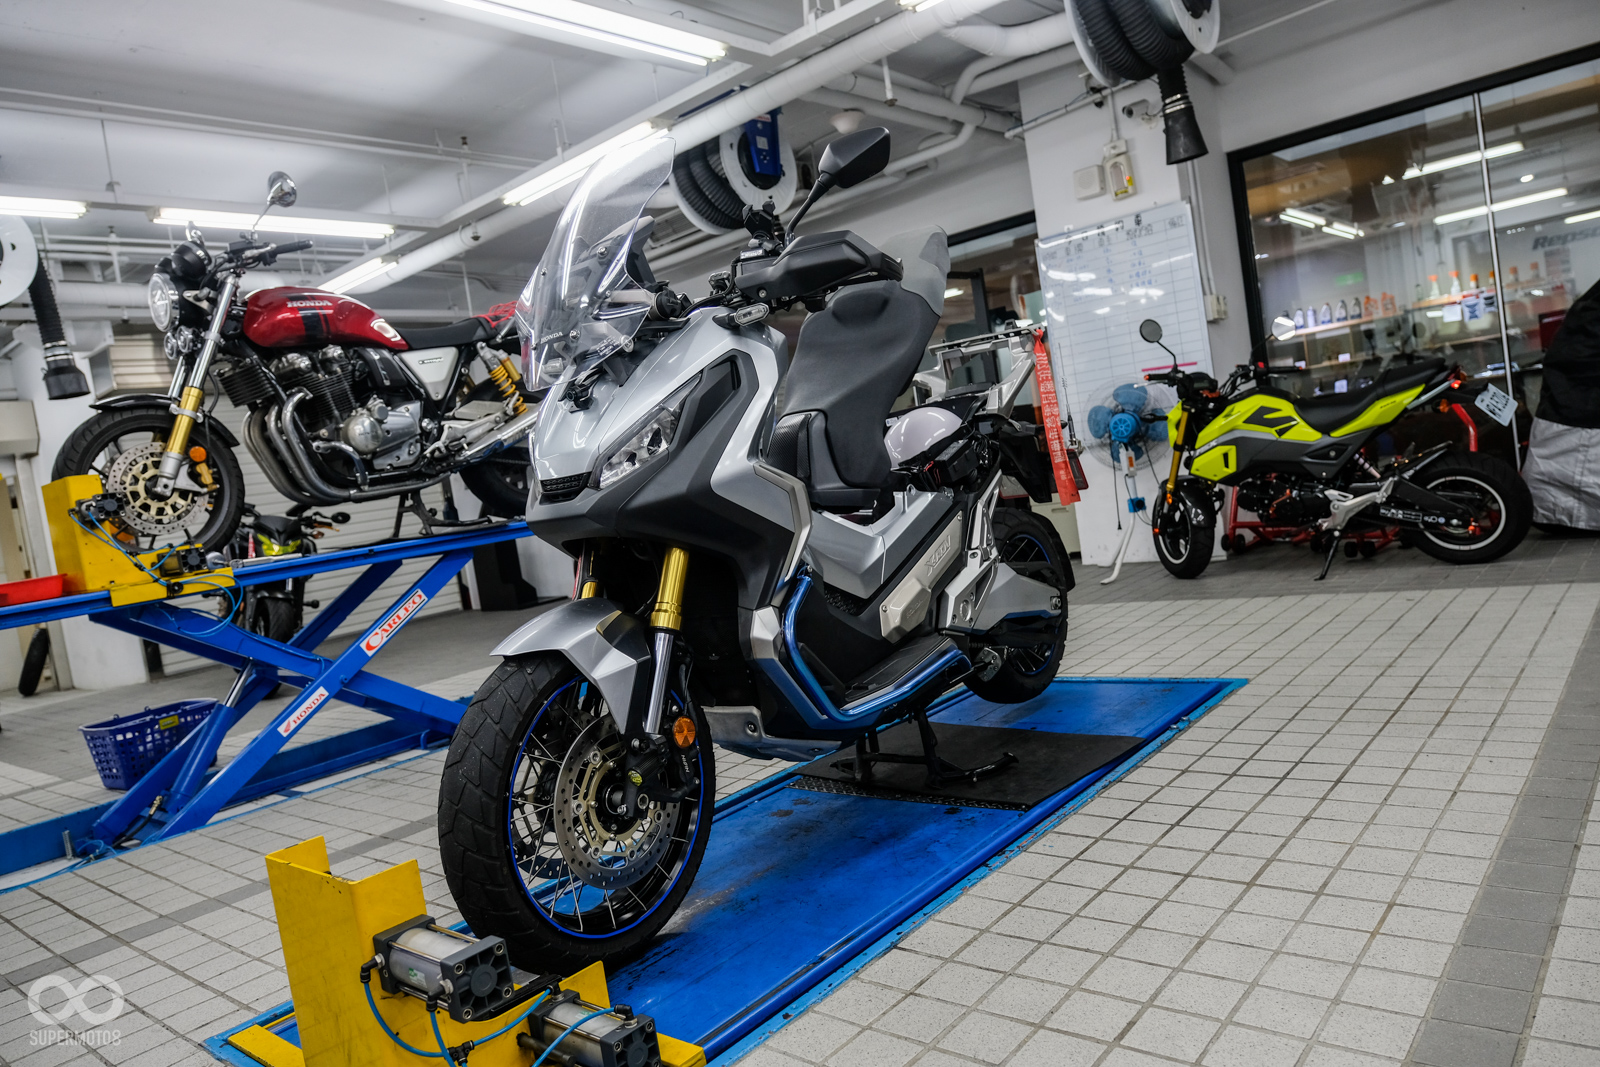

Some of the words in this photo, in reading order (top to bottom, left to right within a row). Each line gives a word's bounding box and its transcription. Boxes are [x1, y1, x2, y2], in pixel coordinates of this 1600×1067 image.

[286, 300, 333, 308] HONDA
[540, 331, 564, 344] HONDA
[365, 594, 422, 652] CARLEO
[292, 693, 326, 725] HONDA
